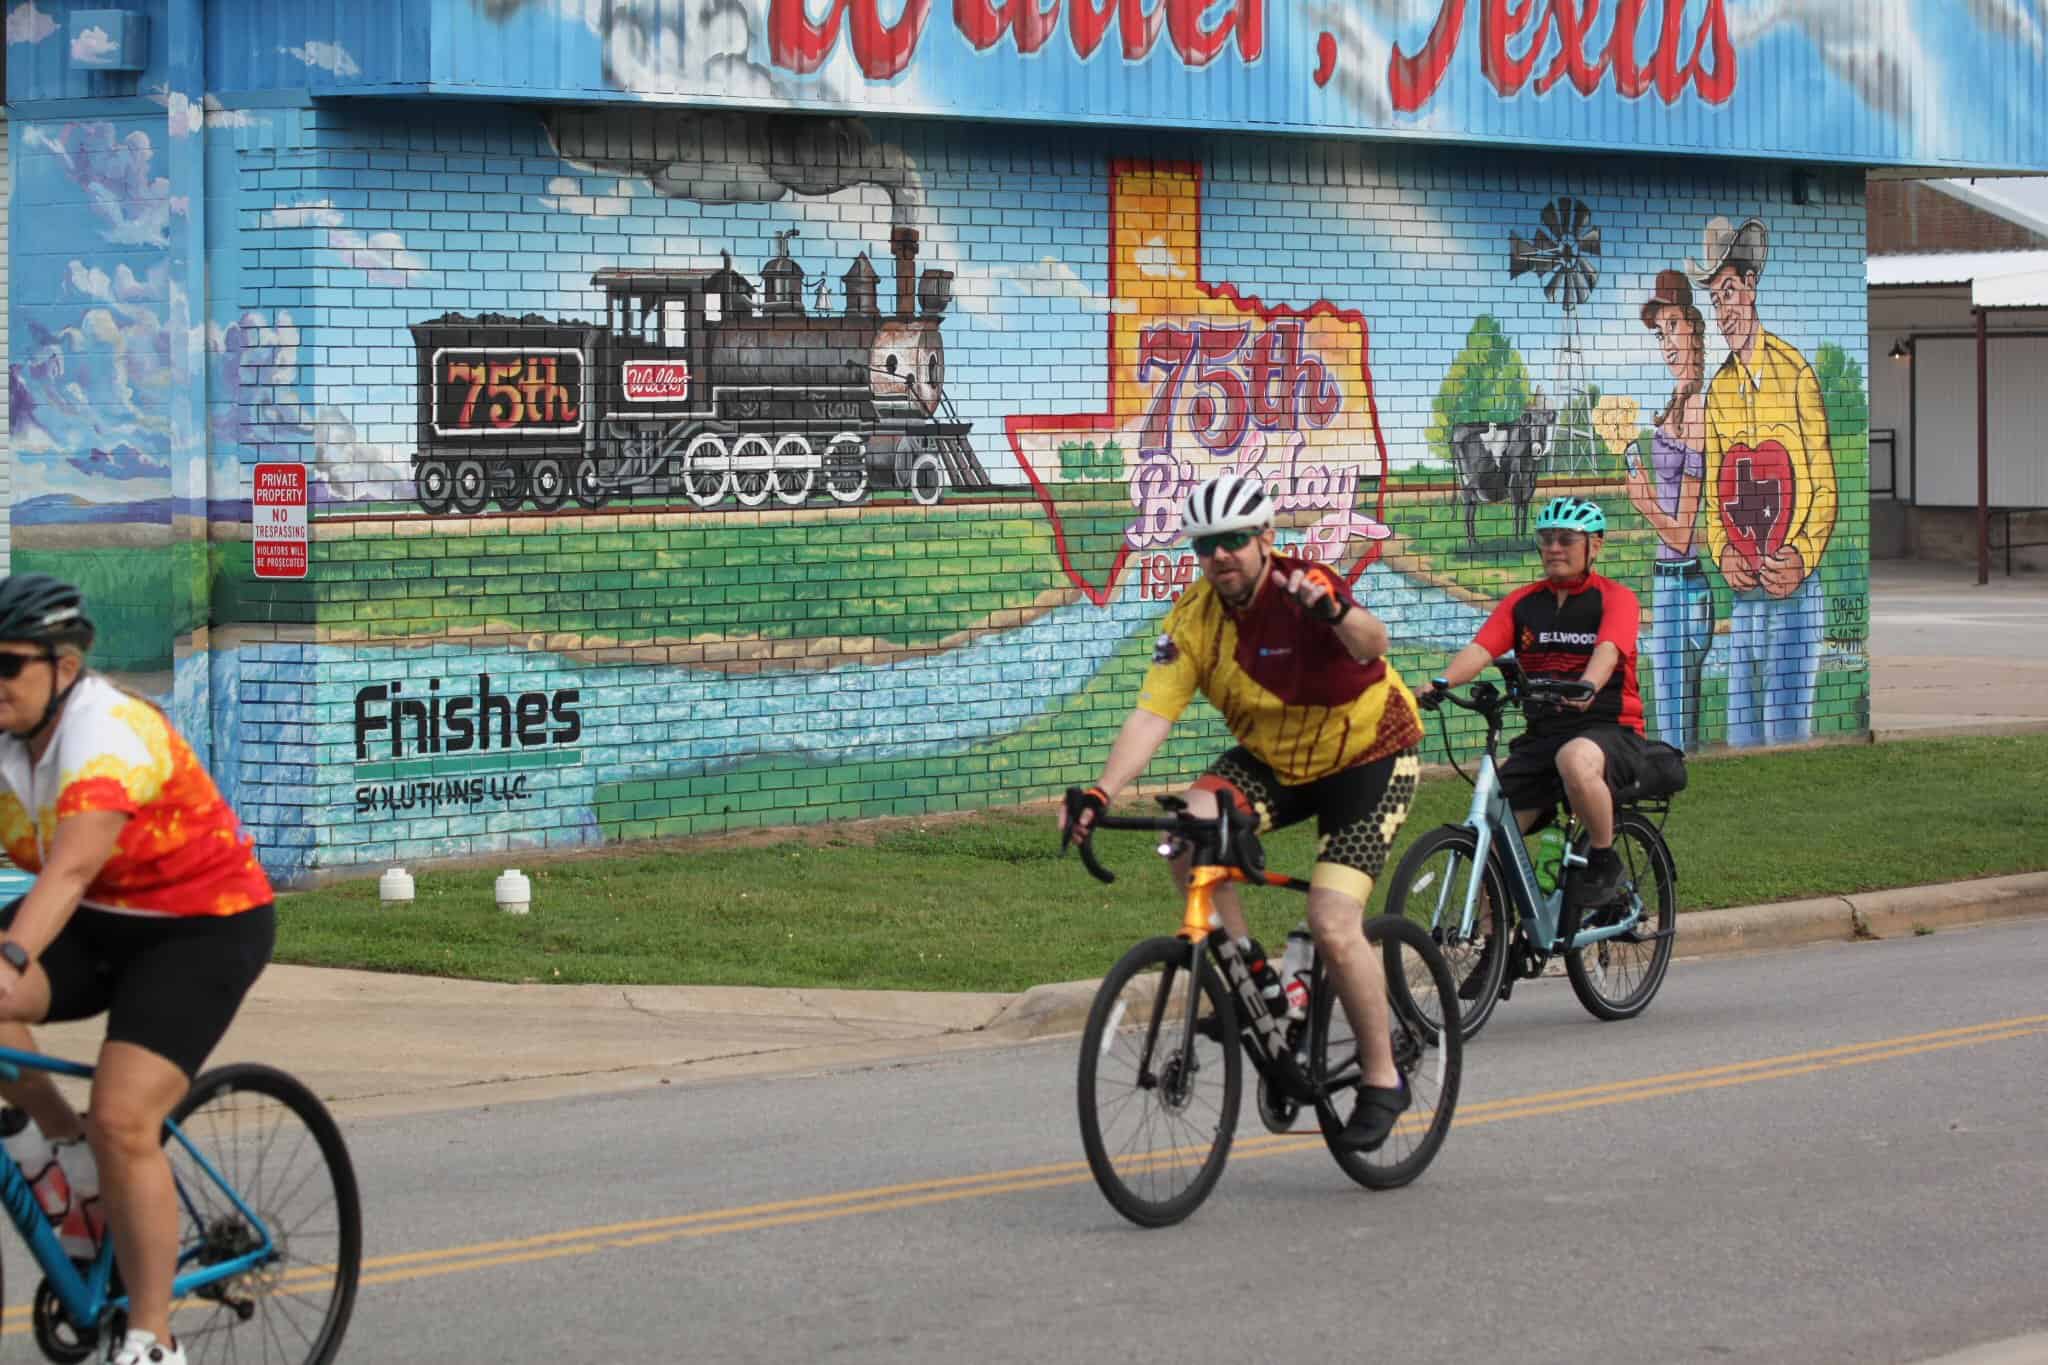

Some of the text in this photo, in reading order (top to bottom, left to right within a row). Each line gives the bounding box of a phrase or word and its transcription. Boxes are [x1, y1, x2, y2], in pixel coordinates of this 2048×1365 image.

[448, 357, 577, 428] 75th
[1137, 318, 1342, 458] 75th
[261, 473, 298, 487] PRIVATE
[256, 488, 303, 502] PROPERTY
[1125, 430, 1392, 563] Bihday
[272, 508, 288, 522] NO
[255, 525, 305, 538] TRESPASSING
[256, 545, 305, 556] VIOLATORS WILL
[256, 557, 305, 568] BE PROSECUTED
[1139, 553, 1196, 602] 194
[1539, 631, 1597, 645] ELLWOOD
[355, 673, 582, 760] Finishes
[355, 777, 485, 814] SOLUTIONS
[1218, 941, 1291, 1060] REK
